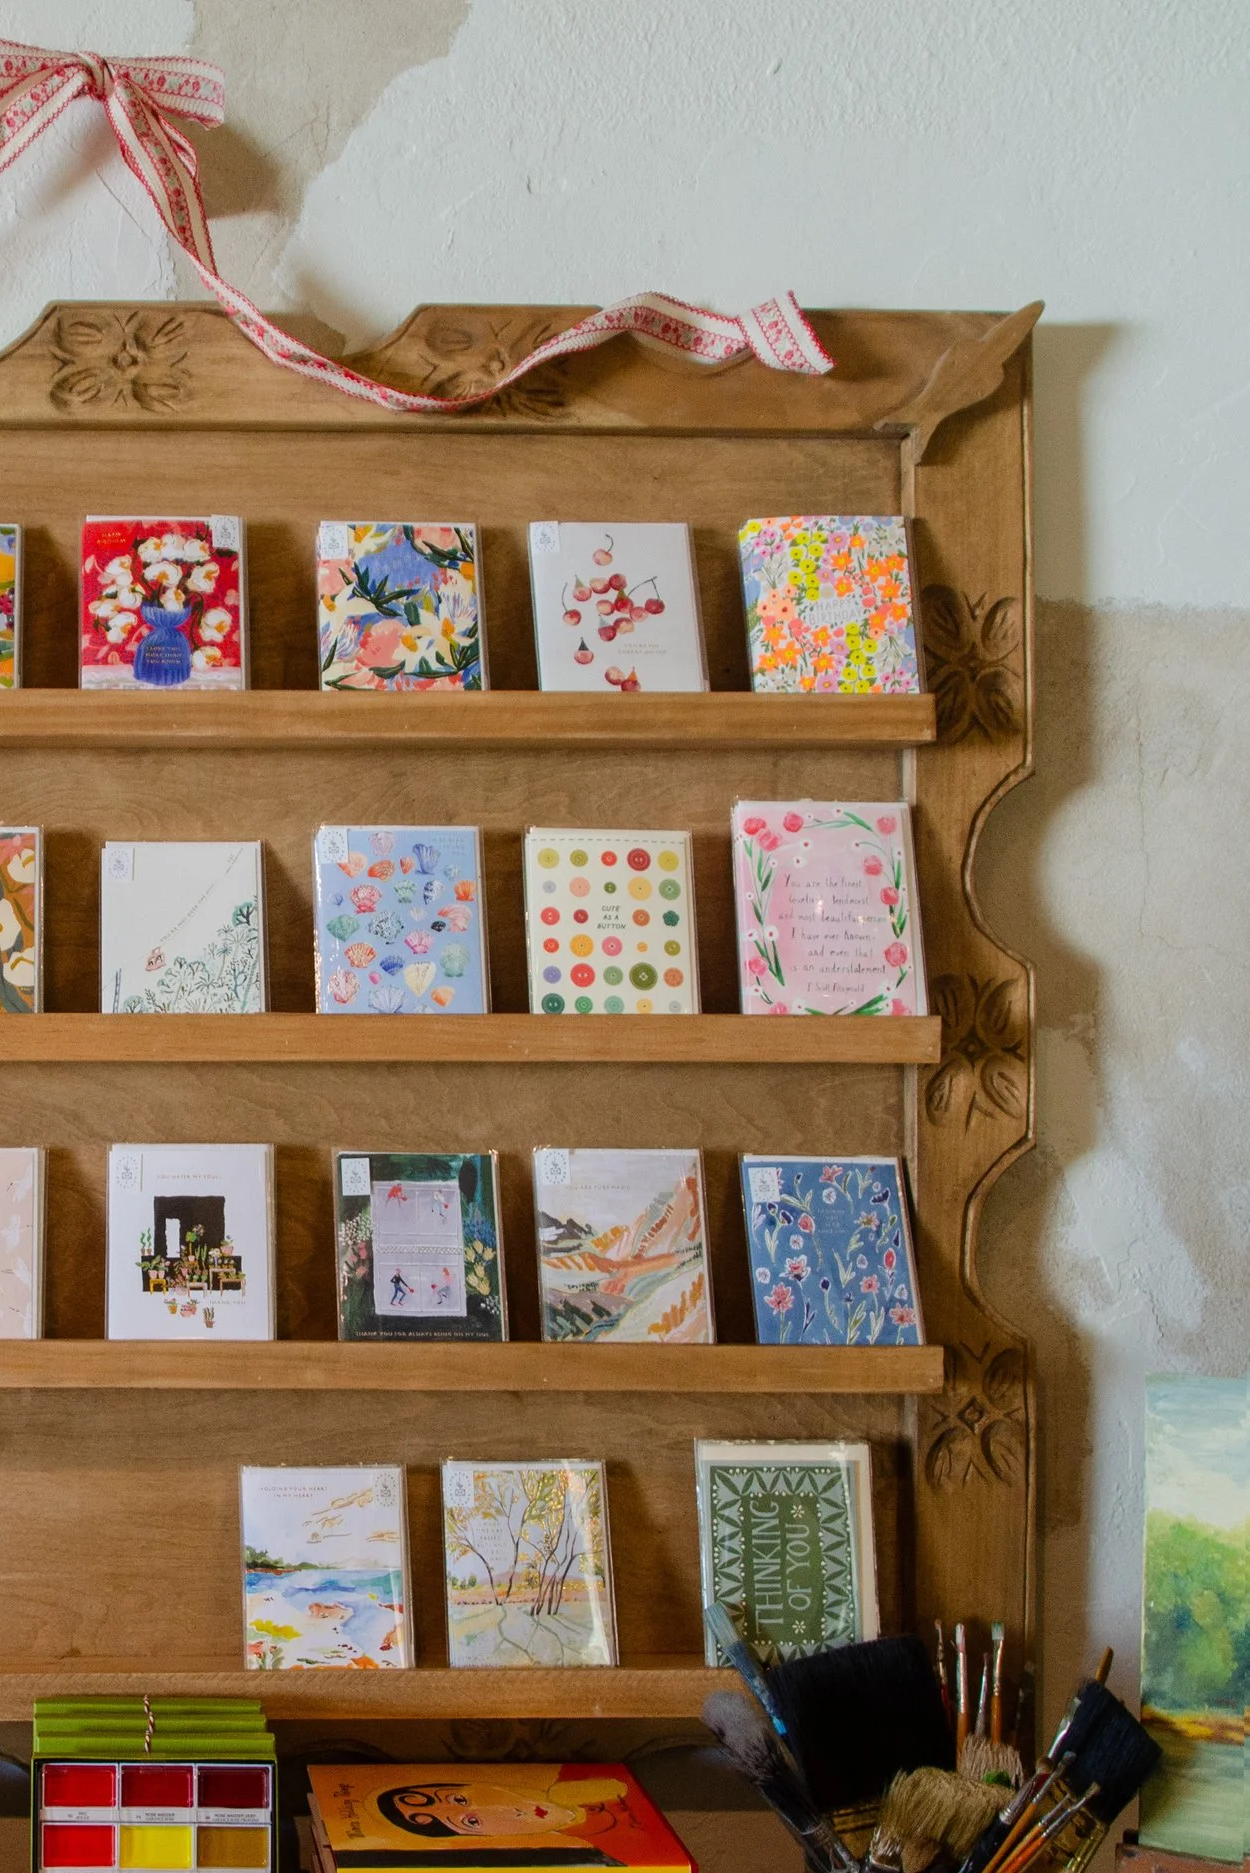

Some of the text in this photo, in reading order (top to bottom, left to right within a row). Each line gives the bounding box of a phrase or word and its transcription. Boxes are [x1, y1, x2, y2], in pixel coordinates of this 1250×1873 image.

[815, 599, 851, 611] HAPPY
[809, 608, 862, 625] BIRTHDAY
[784, 873, 801, 888] You
[806, 880, 820, 888] are
[825, 877, 839, 888] the
[601, 904, 621, 913] CUTE
[778, 908, 794, 919] and
[798, 912, 816, 921] most
[791, 927, 796, 939] I
[801, 931, 819, 943] have
[808, 945, 824, 957] and
[855, 947, 873, 958] that
[803, 964, 814, 972] an
[819, 962, 886, 974] understatement
[749, 1499, 784, 1635] THINKING
[784, 1523, 812, 1611] OF YOU
